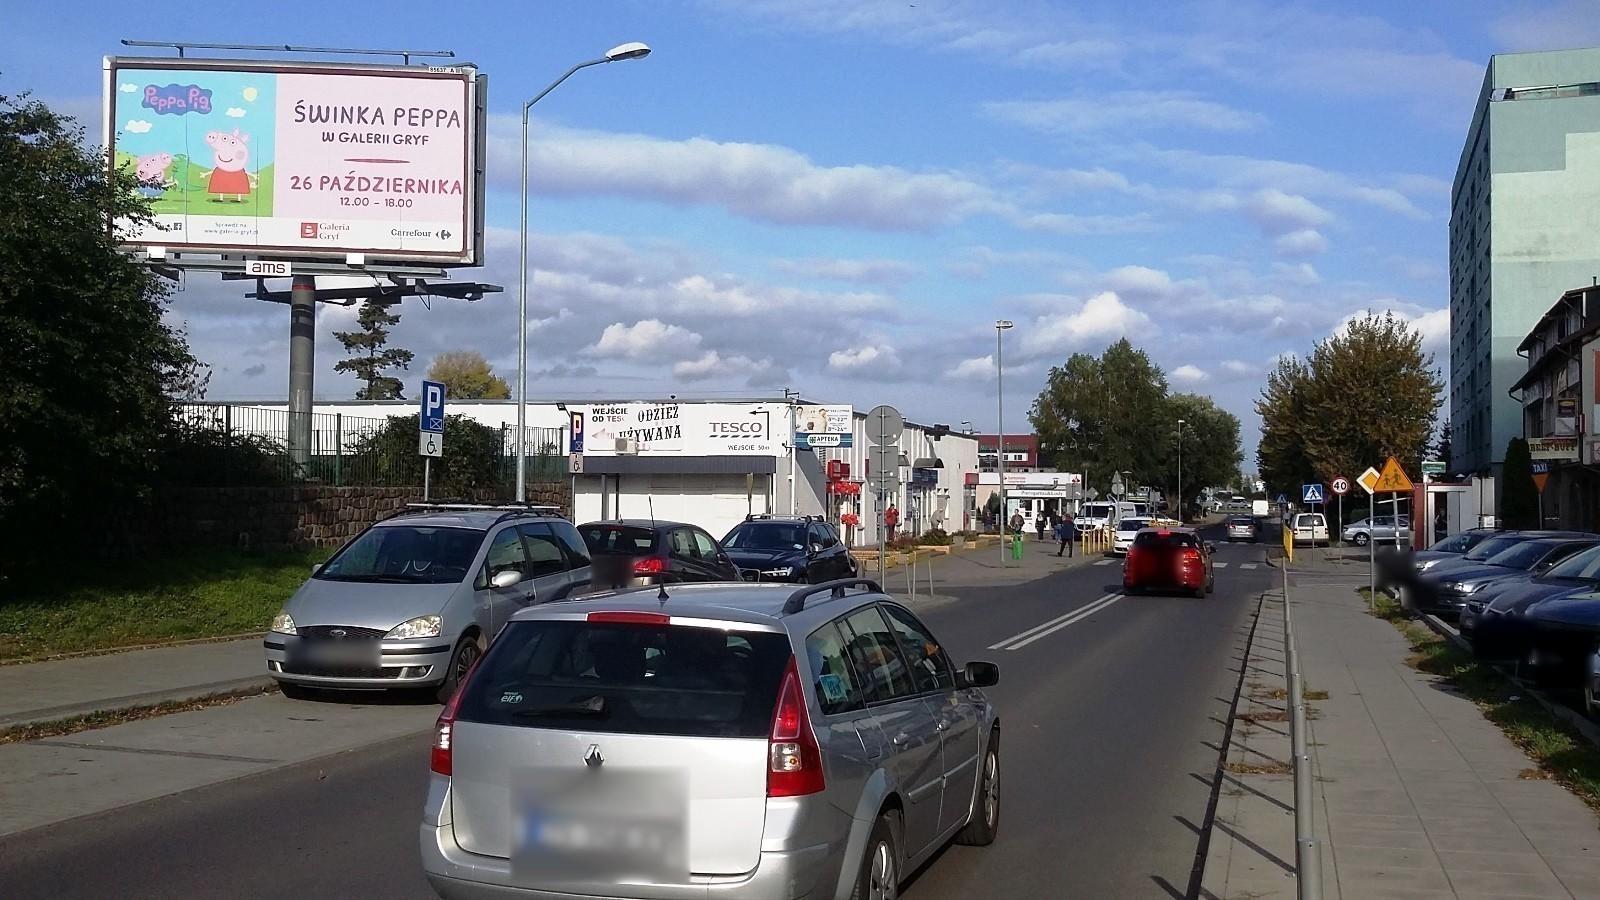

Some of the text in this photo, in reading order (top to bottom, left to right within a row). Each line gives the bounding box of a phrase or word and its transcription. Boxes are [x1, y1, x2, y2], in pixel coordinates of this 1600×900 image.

[146, 86, 210, 111] Peppa Pig
[294, 99, 461, 128] ŚWINKA PEPPA
[322, 131, 430, 146] W GALERII GRYF
[290, 170, 463, 196] 26 PAŹDZIERNIKA
[339, 196, 370, 207] 12.00
[384, 198, 413, 208] 18.00
[319, 222, 350, 231] Galeria
[319, 232, 340, 241] Gryf
[390, 228, 432, 238] Carrefour
[251, 262, 286, 274] ams
[426, 385, 441, 417] P
[637, 403, 679, 422] ODZIEŻ
[591, 415, 605, 423] OD
[573, 414, 582, 441] P
[708, 422, 763, 433] TESCO
[1532, 463, 1549, 473] TAXI
[1333, 480, 1348, 492] 40
